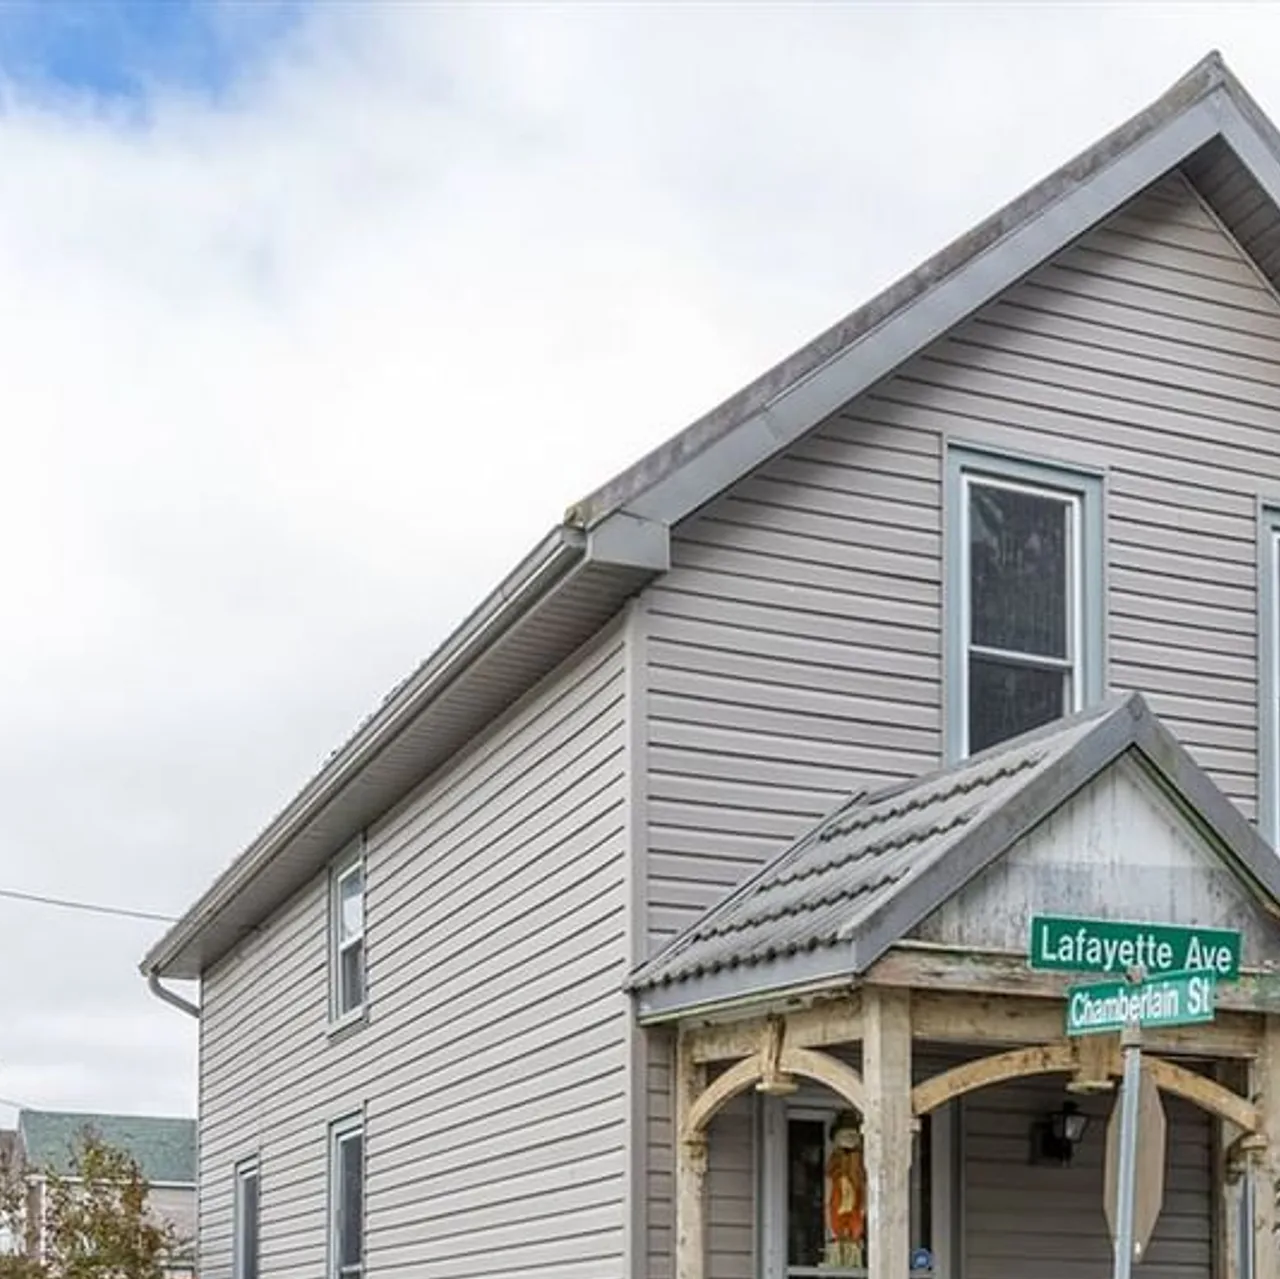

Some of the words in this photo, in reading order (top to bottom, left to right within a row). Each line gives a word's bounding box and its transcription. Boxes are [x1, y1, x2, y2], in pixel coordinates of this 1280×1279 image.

[1041, 924, 1173, 972] Lafayette
[1184, 936, 1232, 973] Ave
[1071, 981, 1179, 1028] Chamberlain
[1187, 977, 1210, 1015] St
